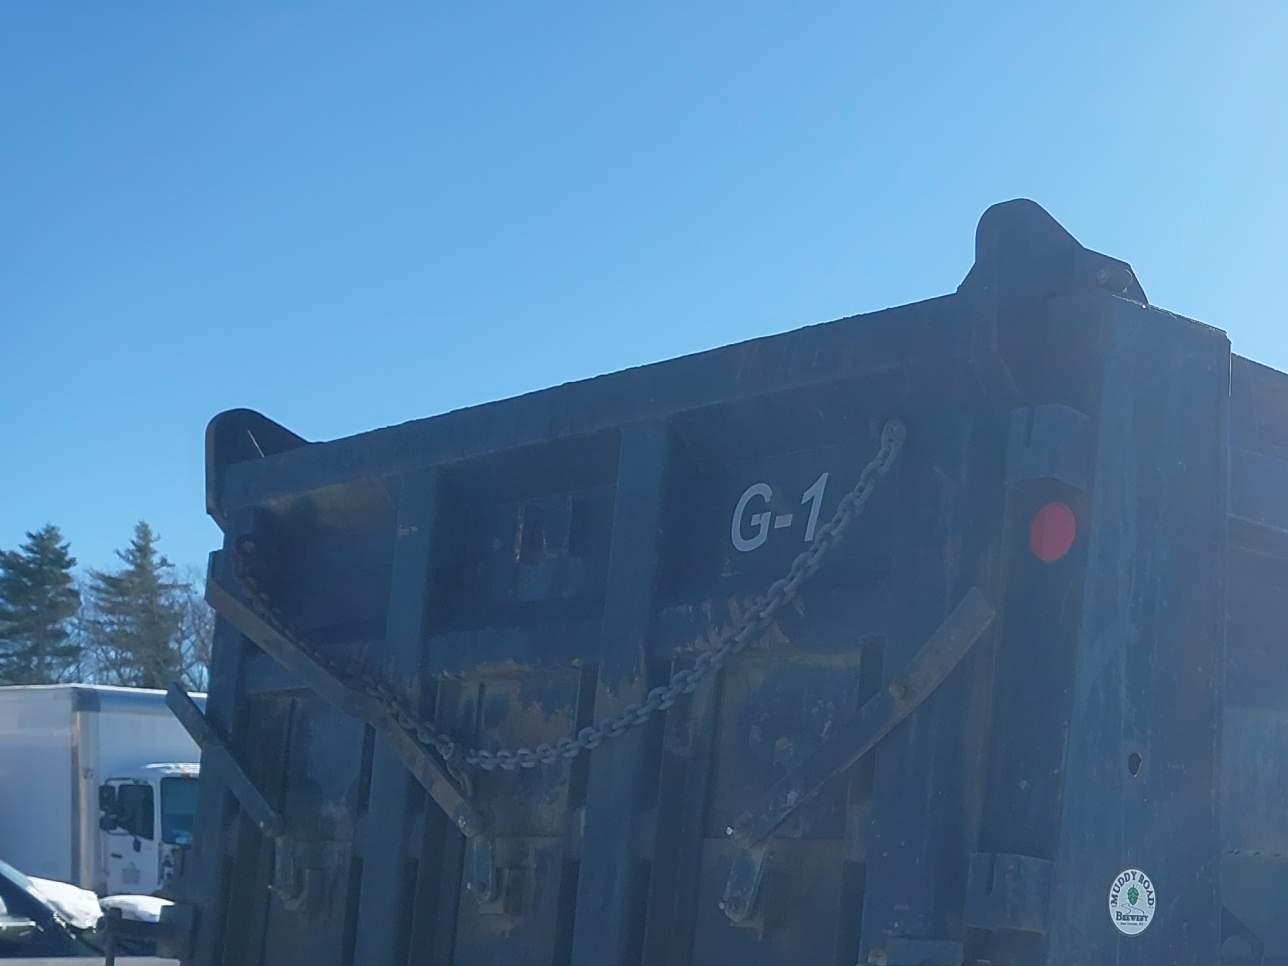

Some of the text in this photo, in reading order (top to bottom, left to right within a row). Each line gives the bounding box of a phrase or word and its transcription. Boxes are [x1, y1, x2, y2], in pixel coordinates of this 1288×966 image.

[731, 472, 829, 552] G-1
[1110, 870, 1155, 907] MUDDY ROAD
